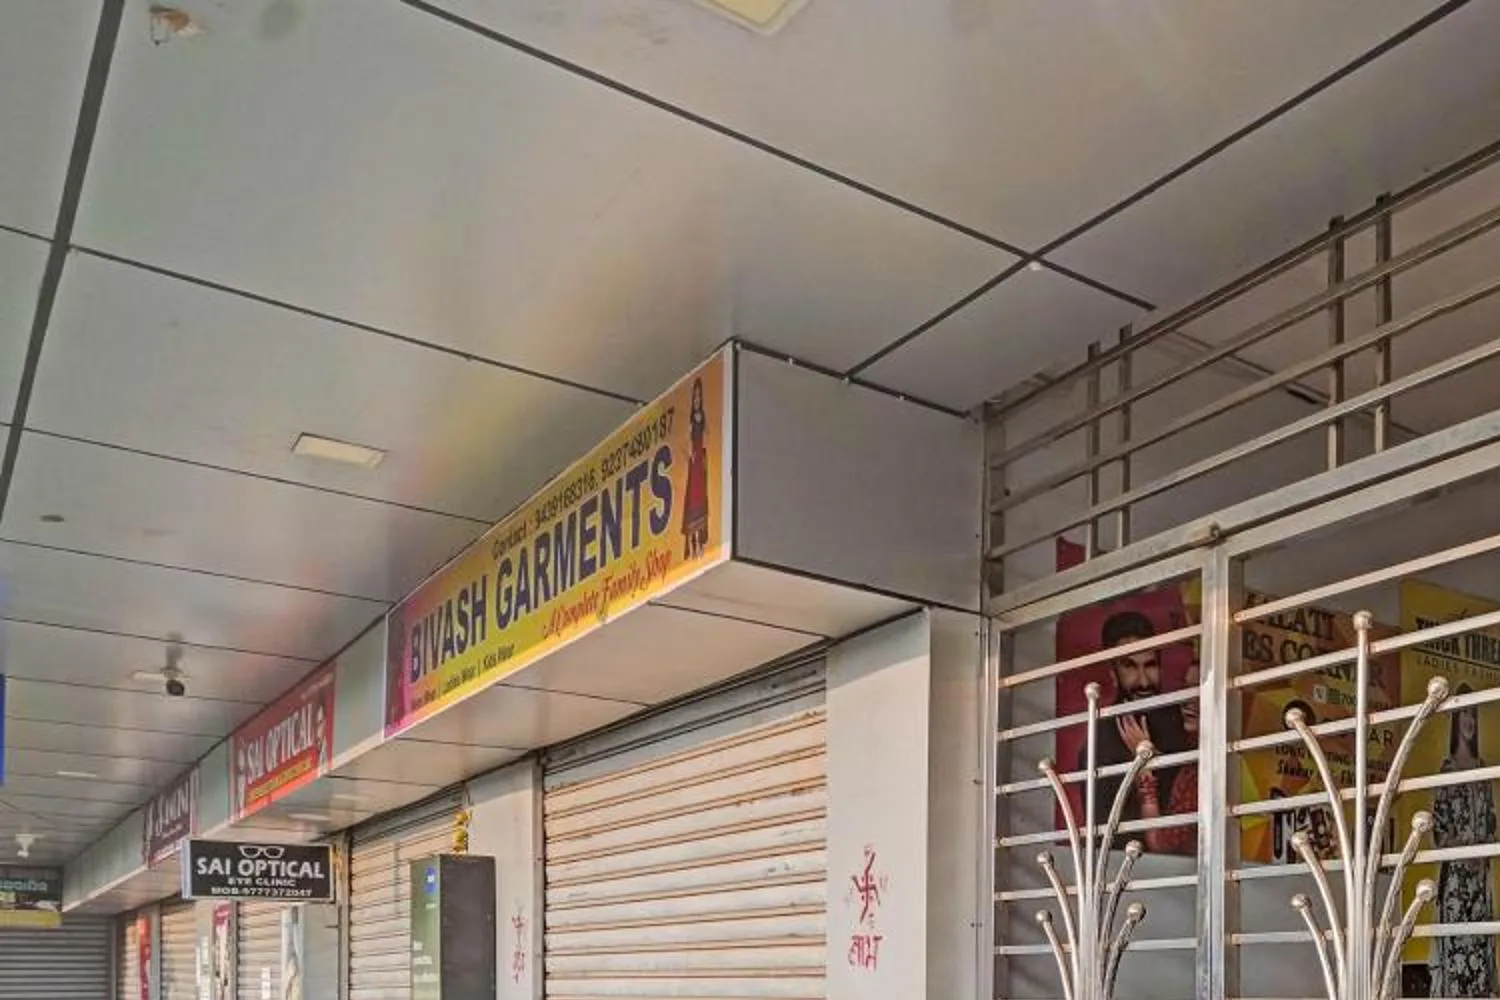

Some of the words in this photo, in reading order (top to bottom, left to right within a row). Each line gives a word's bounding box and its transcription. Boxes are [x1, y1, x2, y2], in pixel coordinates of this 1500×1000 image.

[410, 574, 489, 683] BIVASH
[495, 445, 673, 631] GARMENTS
[266, 703, 315, 773] OPTICAL
[197, 857, 231, 875] SAI
[237, 859, 325, 879] OPTICAL
[255, 877, 297, 887] CLINIC
